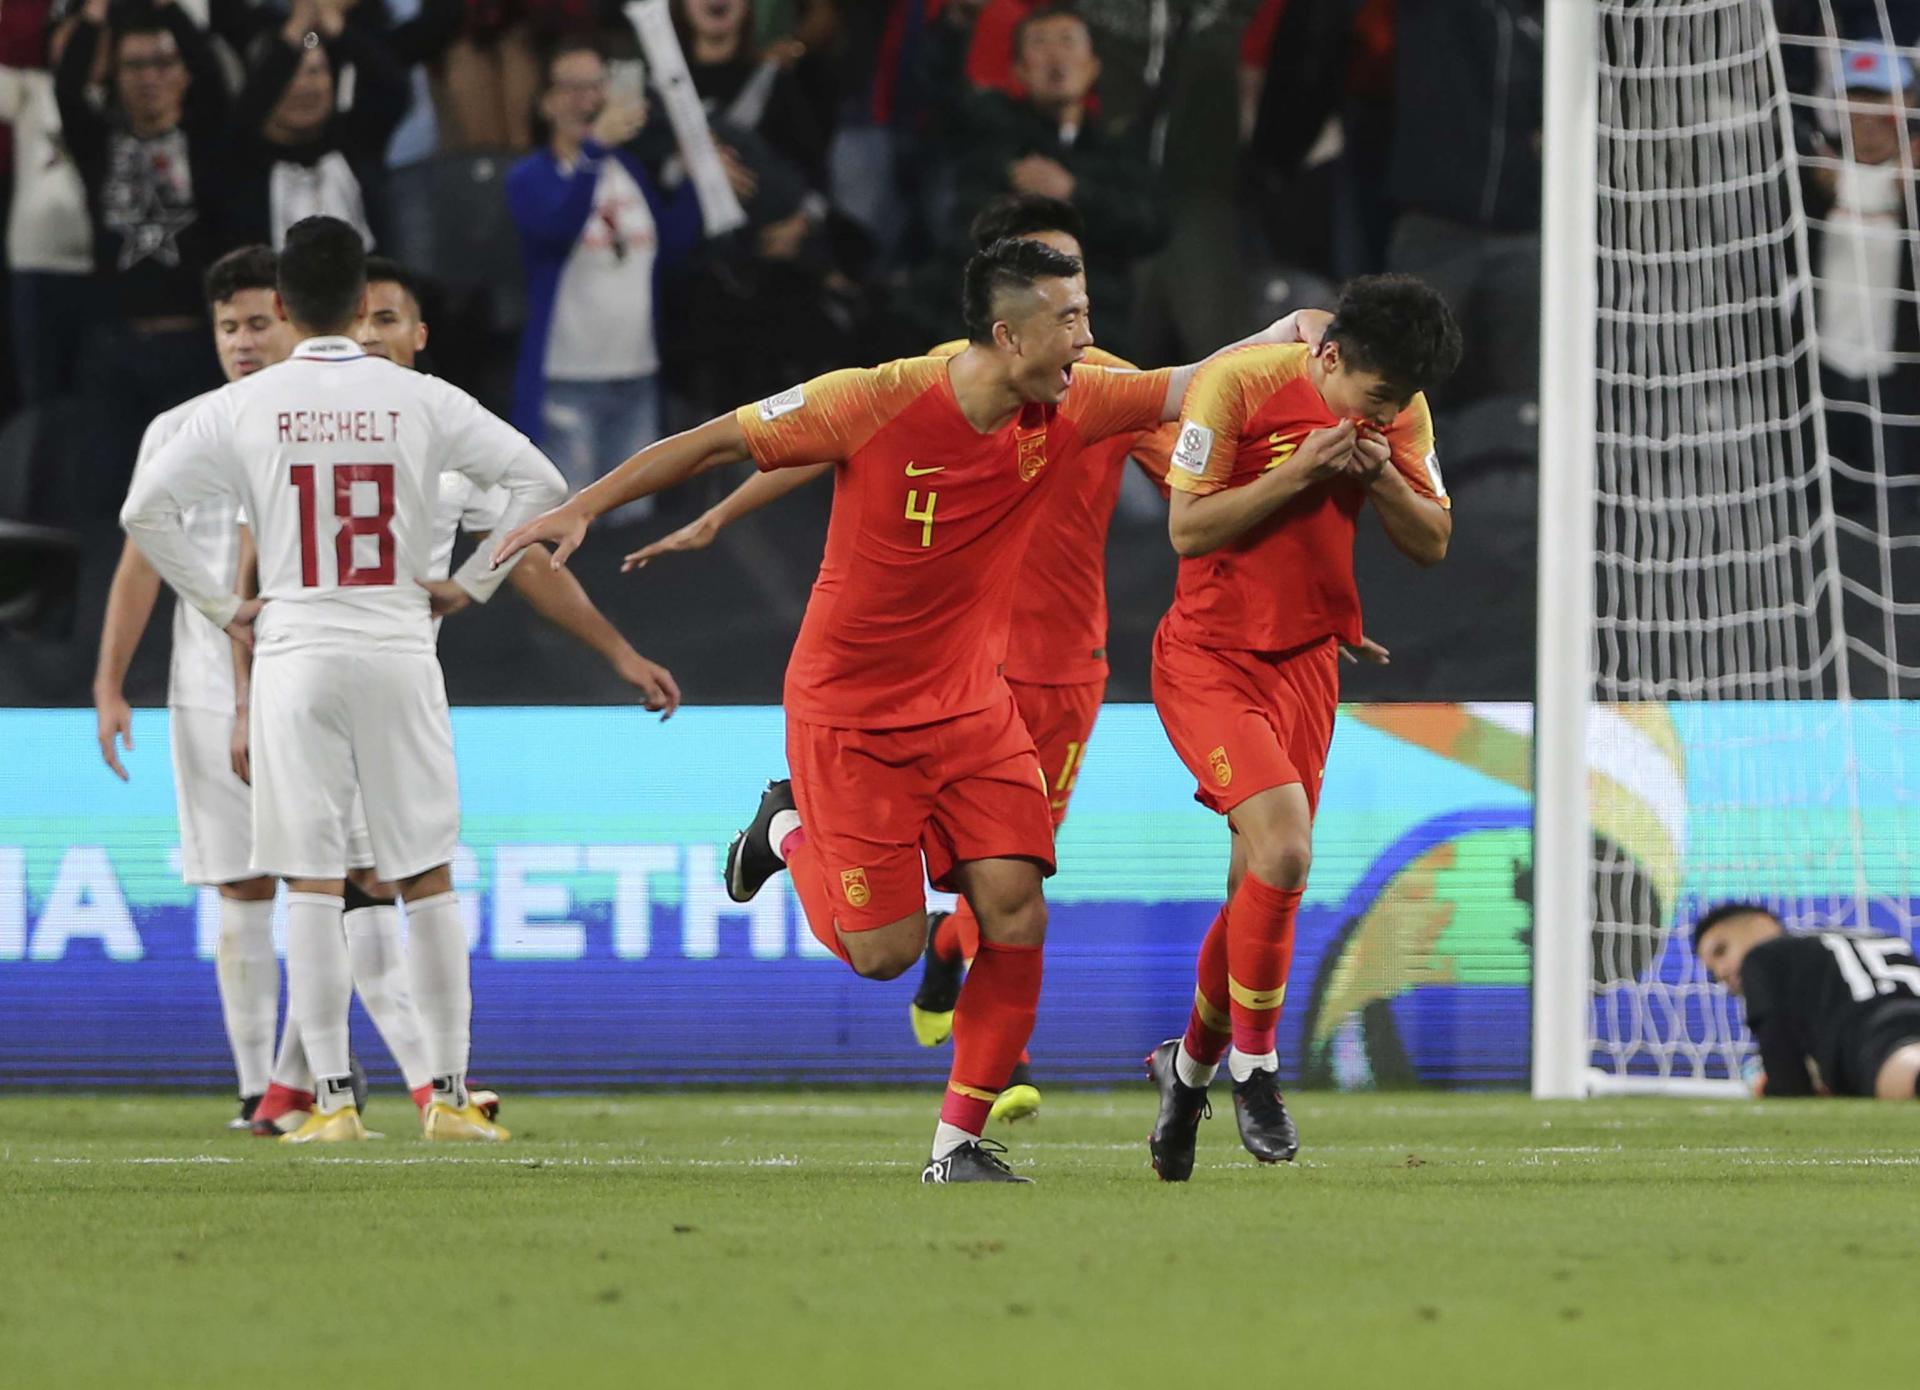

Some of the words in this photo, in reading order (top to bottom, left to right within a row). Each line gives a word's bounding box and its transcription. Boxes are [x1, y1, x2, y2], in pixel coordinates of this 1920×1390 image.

[277, 411, 401, 443] REICHELT
[290, 464, 396, 587] 18
[904, 490, 937, 547] 4
[1820, 932, 1920, 1002] 15
[921, 1156, 953, 1184] CR7
